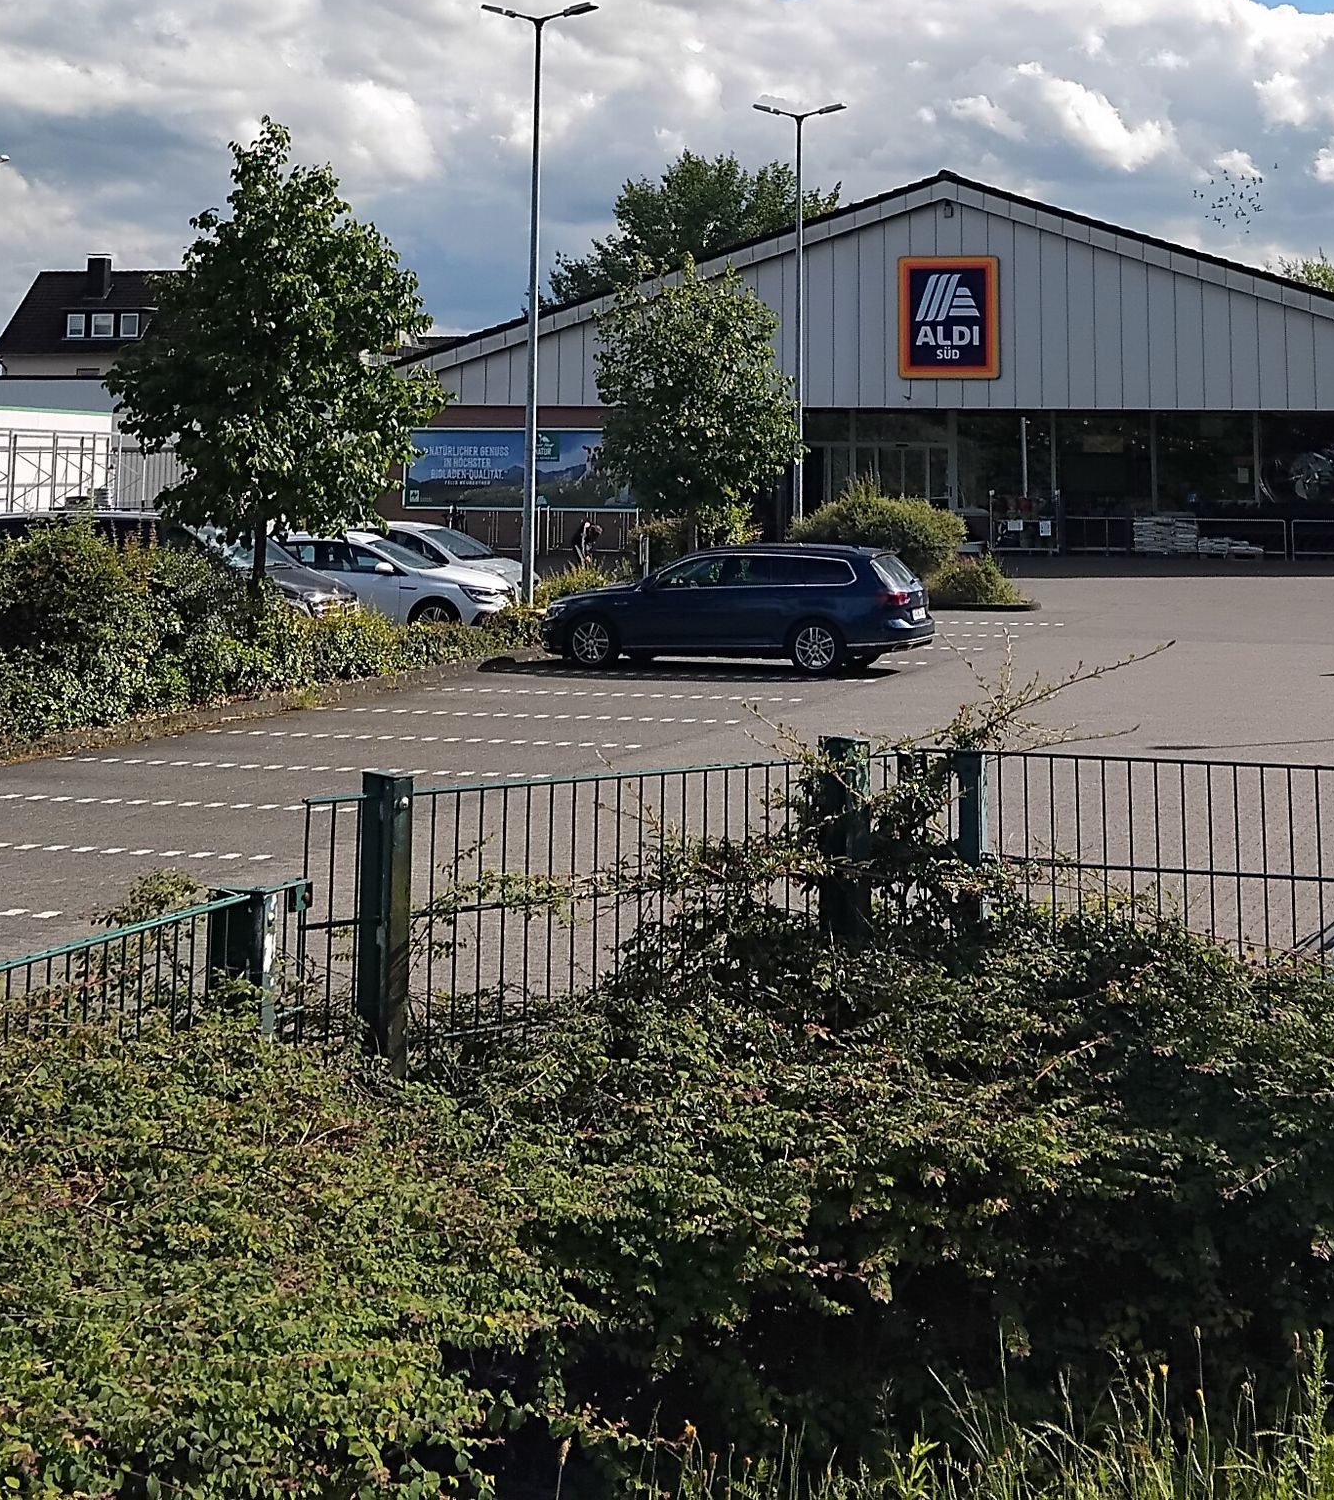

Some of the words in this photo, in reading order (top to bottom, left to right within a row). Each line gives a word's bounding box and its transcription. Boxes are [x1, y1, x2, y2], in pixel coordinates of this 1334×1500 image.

[915, 325, 980, 346] ALDI
[936, 346, 960, 359] SÜD
[480, 446, 509, 457] GENUSS
[453, 456, 491, 468] HÖCHSTER
